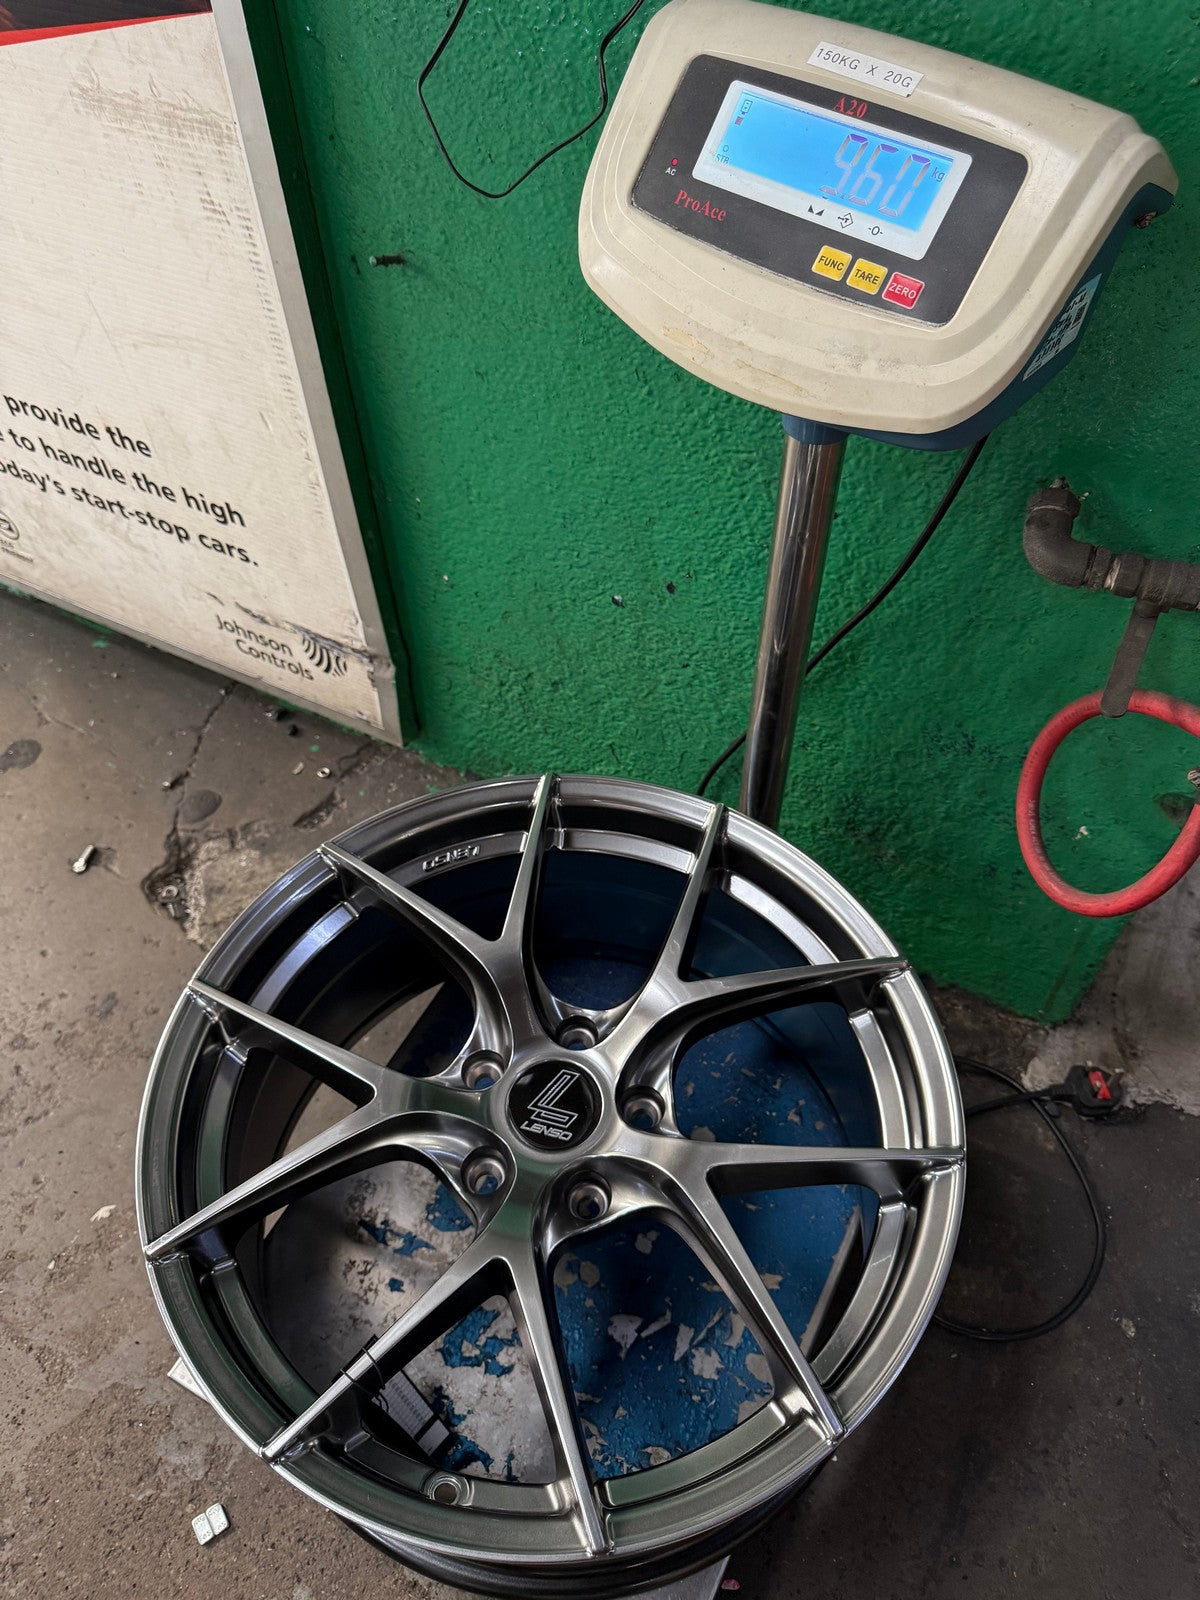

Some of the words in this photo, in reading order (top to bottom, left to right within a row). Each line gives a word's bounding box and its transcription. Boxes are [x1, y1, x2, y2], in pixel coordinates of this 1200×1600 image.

[816, 48, 860, 71] 150KG
[866, 64, 877, 77] X
[883, 70, 913, 88] 20G
[832, 97, 868, 119] A20
[665, 167, 677, 176] AC
[932, 167, 946, 182] kg
[673, 189, 727, 222] ProAce
[818, 255, 845, 272] FUNC
[854, 268, 881, 285] TARE
[888, 282, 917, 300] ZERO
[3, 395, 101, 441] provide
[105, 426, 152, 458] the
[8, 428, 36, 452] to
[38, 437, 127, 485] handle
[132, 472, 176, 503] the
[182, 487, 246, 527] high
[71, 487, 190, 544] start-stop
[198, 533, 259, 567] cars.
[216, 614, 293, 656] Johnson
[235, 639, 314, 681] Controls
[520, 1121, 573, 1141] LENSO
